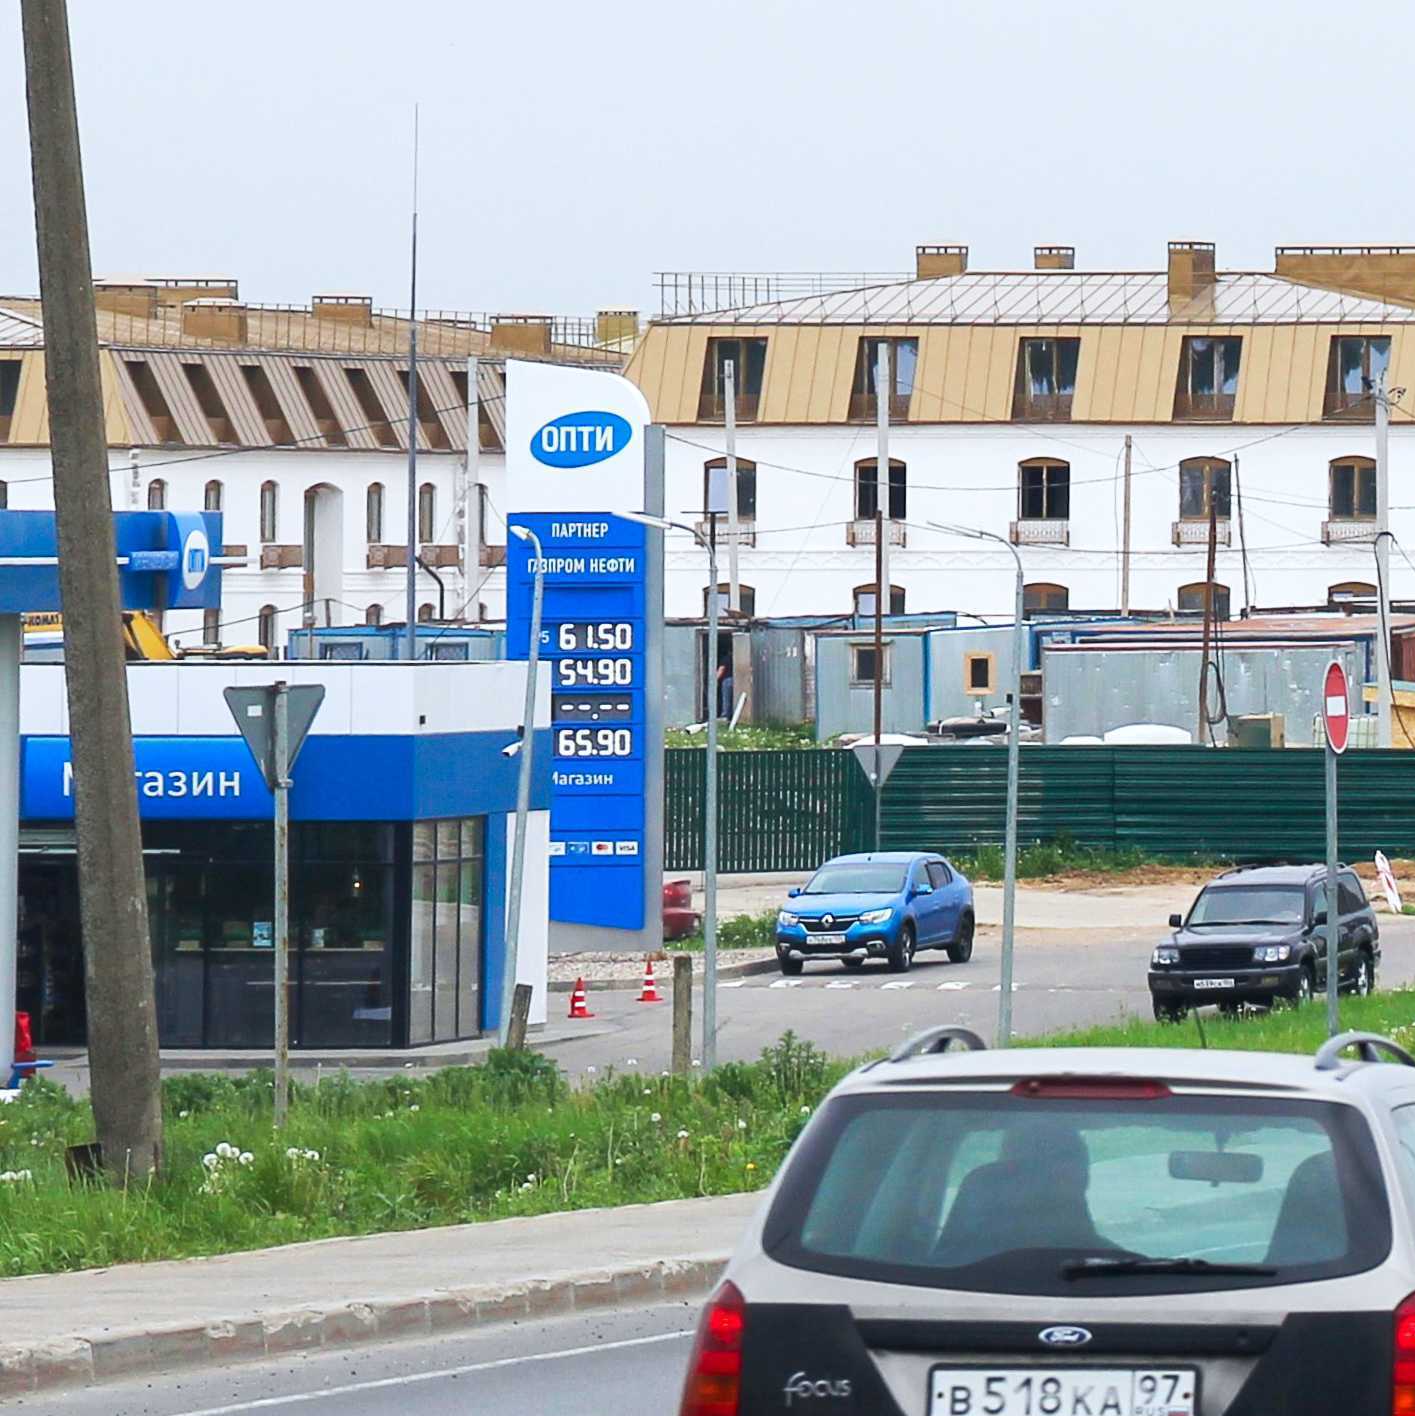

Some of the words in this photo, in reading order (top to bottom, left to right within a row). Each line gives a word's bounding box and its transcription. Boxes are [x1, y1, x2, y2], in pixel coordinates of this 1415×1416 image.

[541, 425, 615, 453] ОПТИ
[551, 522, 609, 538] ПАРТНЕР
[590, 558, 635, 573] НЕФТИ
[559, 623, 632, 650] 61.50
[559, 658, 632, 686] 54.90
[558, 729, 632, 757] 65.90
[63, 761, 241, 797] азин
[1139, 1374, 1181, 1405] 97
